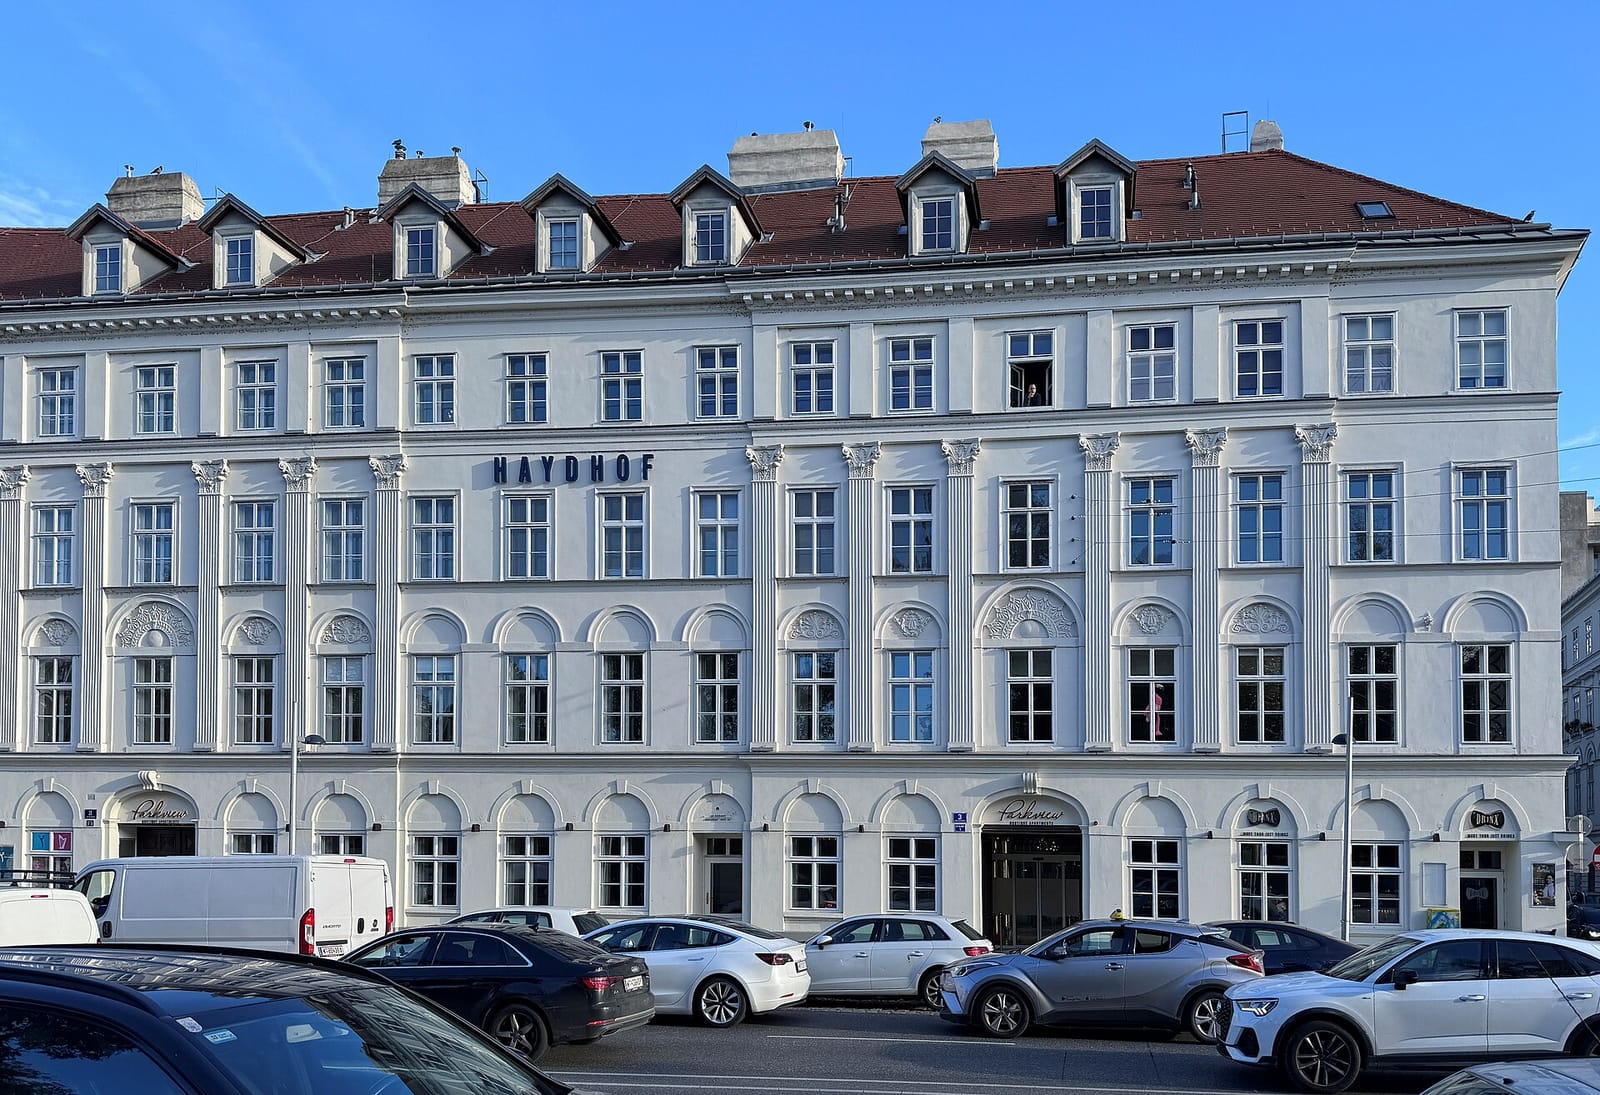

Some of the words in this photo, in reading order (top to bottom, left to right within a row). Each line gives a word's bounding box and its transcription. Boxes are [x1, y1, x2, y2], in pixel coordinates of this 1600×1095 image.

[493, 454, 655, 483] HAYDHOF
[132, 799, 187, 820] Parkview
[998, 799, 1064, 821] Parkview
